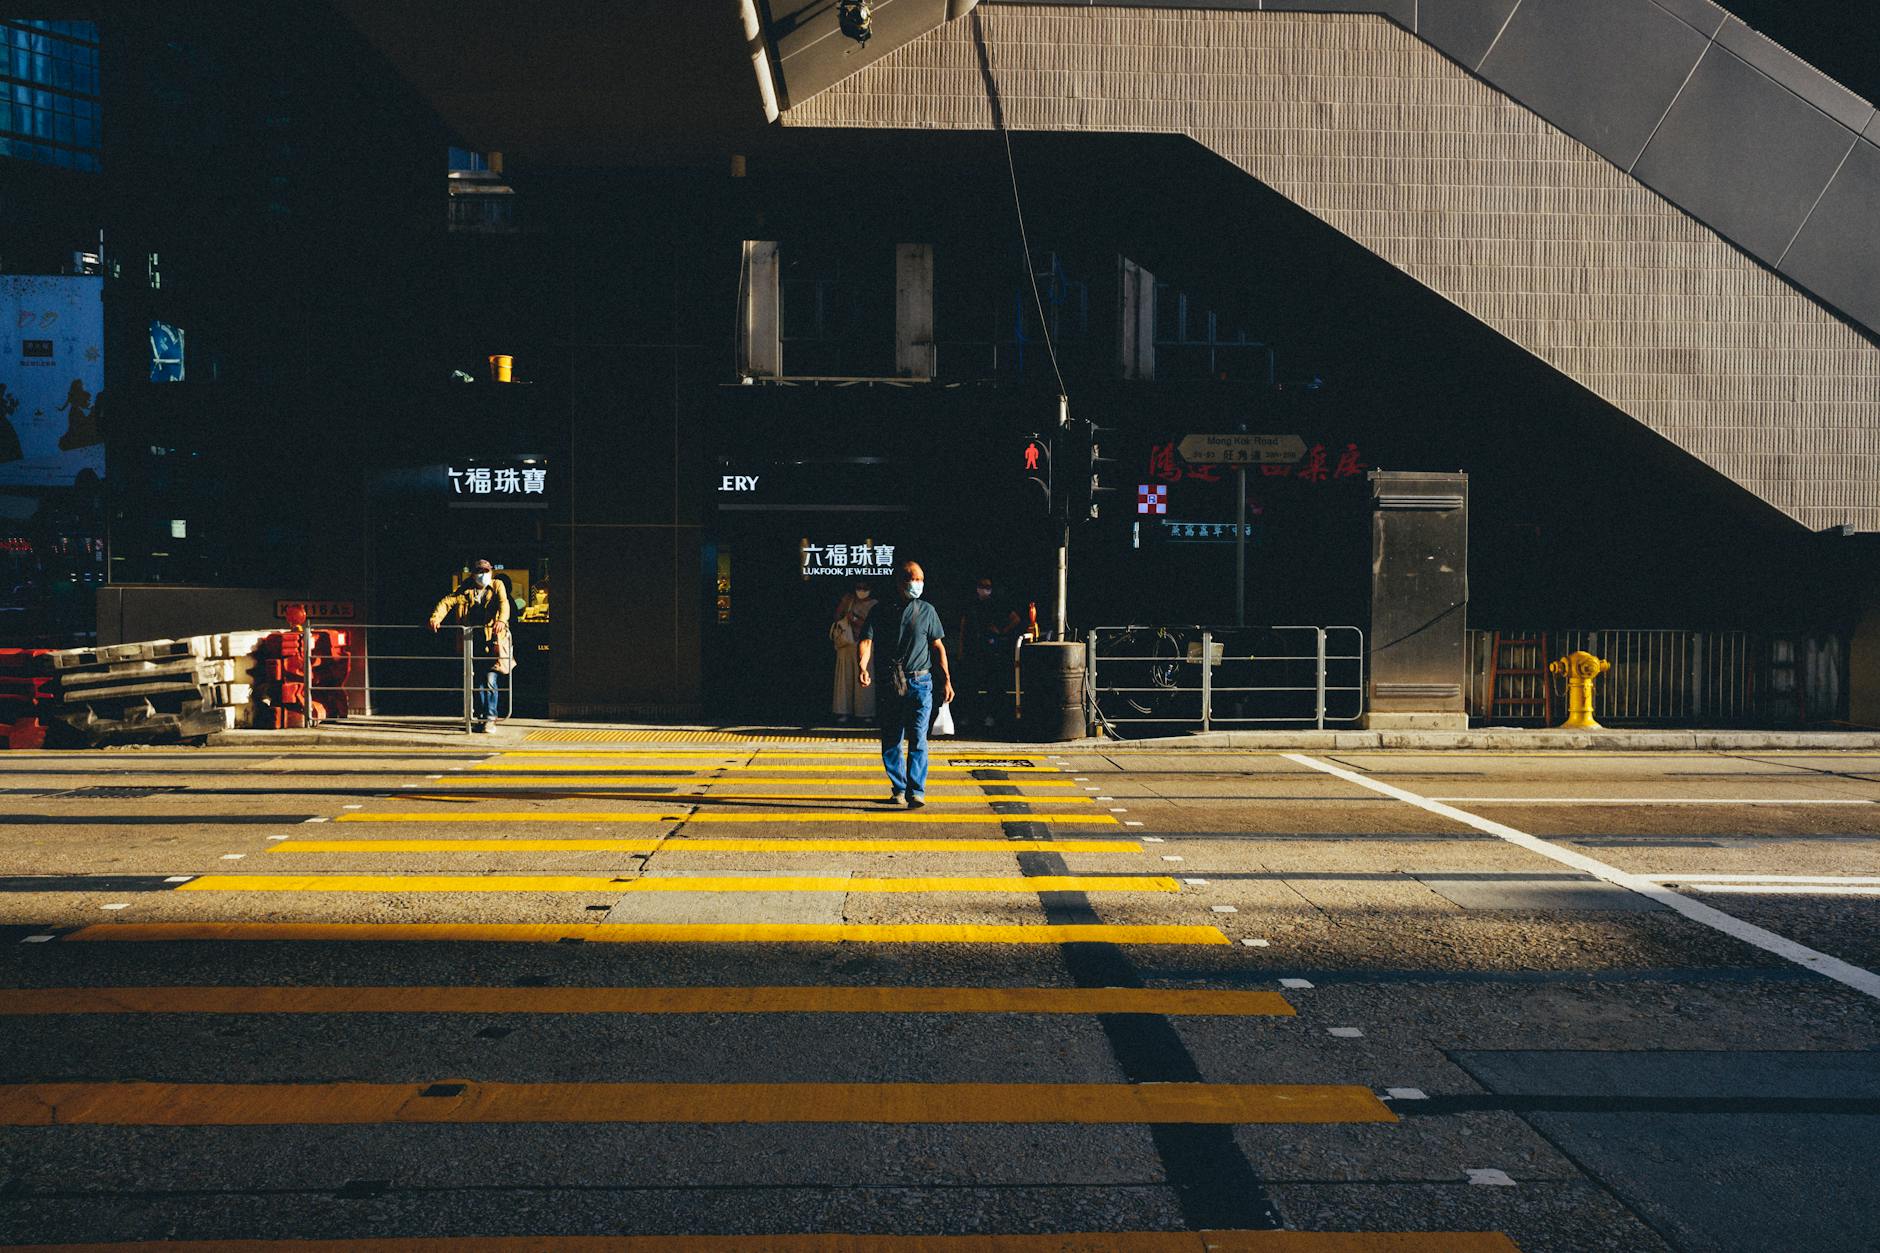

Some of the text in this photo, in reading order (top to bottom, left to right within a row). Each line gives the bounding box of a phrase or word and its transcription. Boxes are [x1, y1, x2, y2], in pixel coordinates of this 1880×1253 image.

[1207, 436, 1232, 446] Mong
[1254, 436, 1279, 446] Road
[448, 467, 547, 494] 六福珠寶
[803, 544, 895, 567] 六福珠寶
[803, 567, 894, 577] LUKFOOK JEWELLERY
